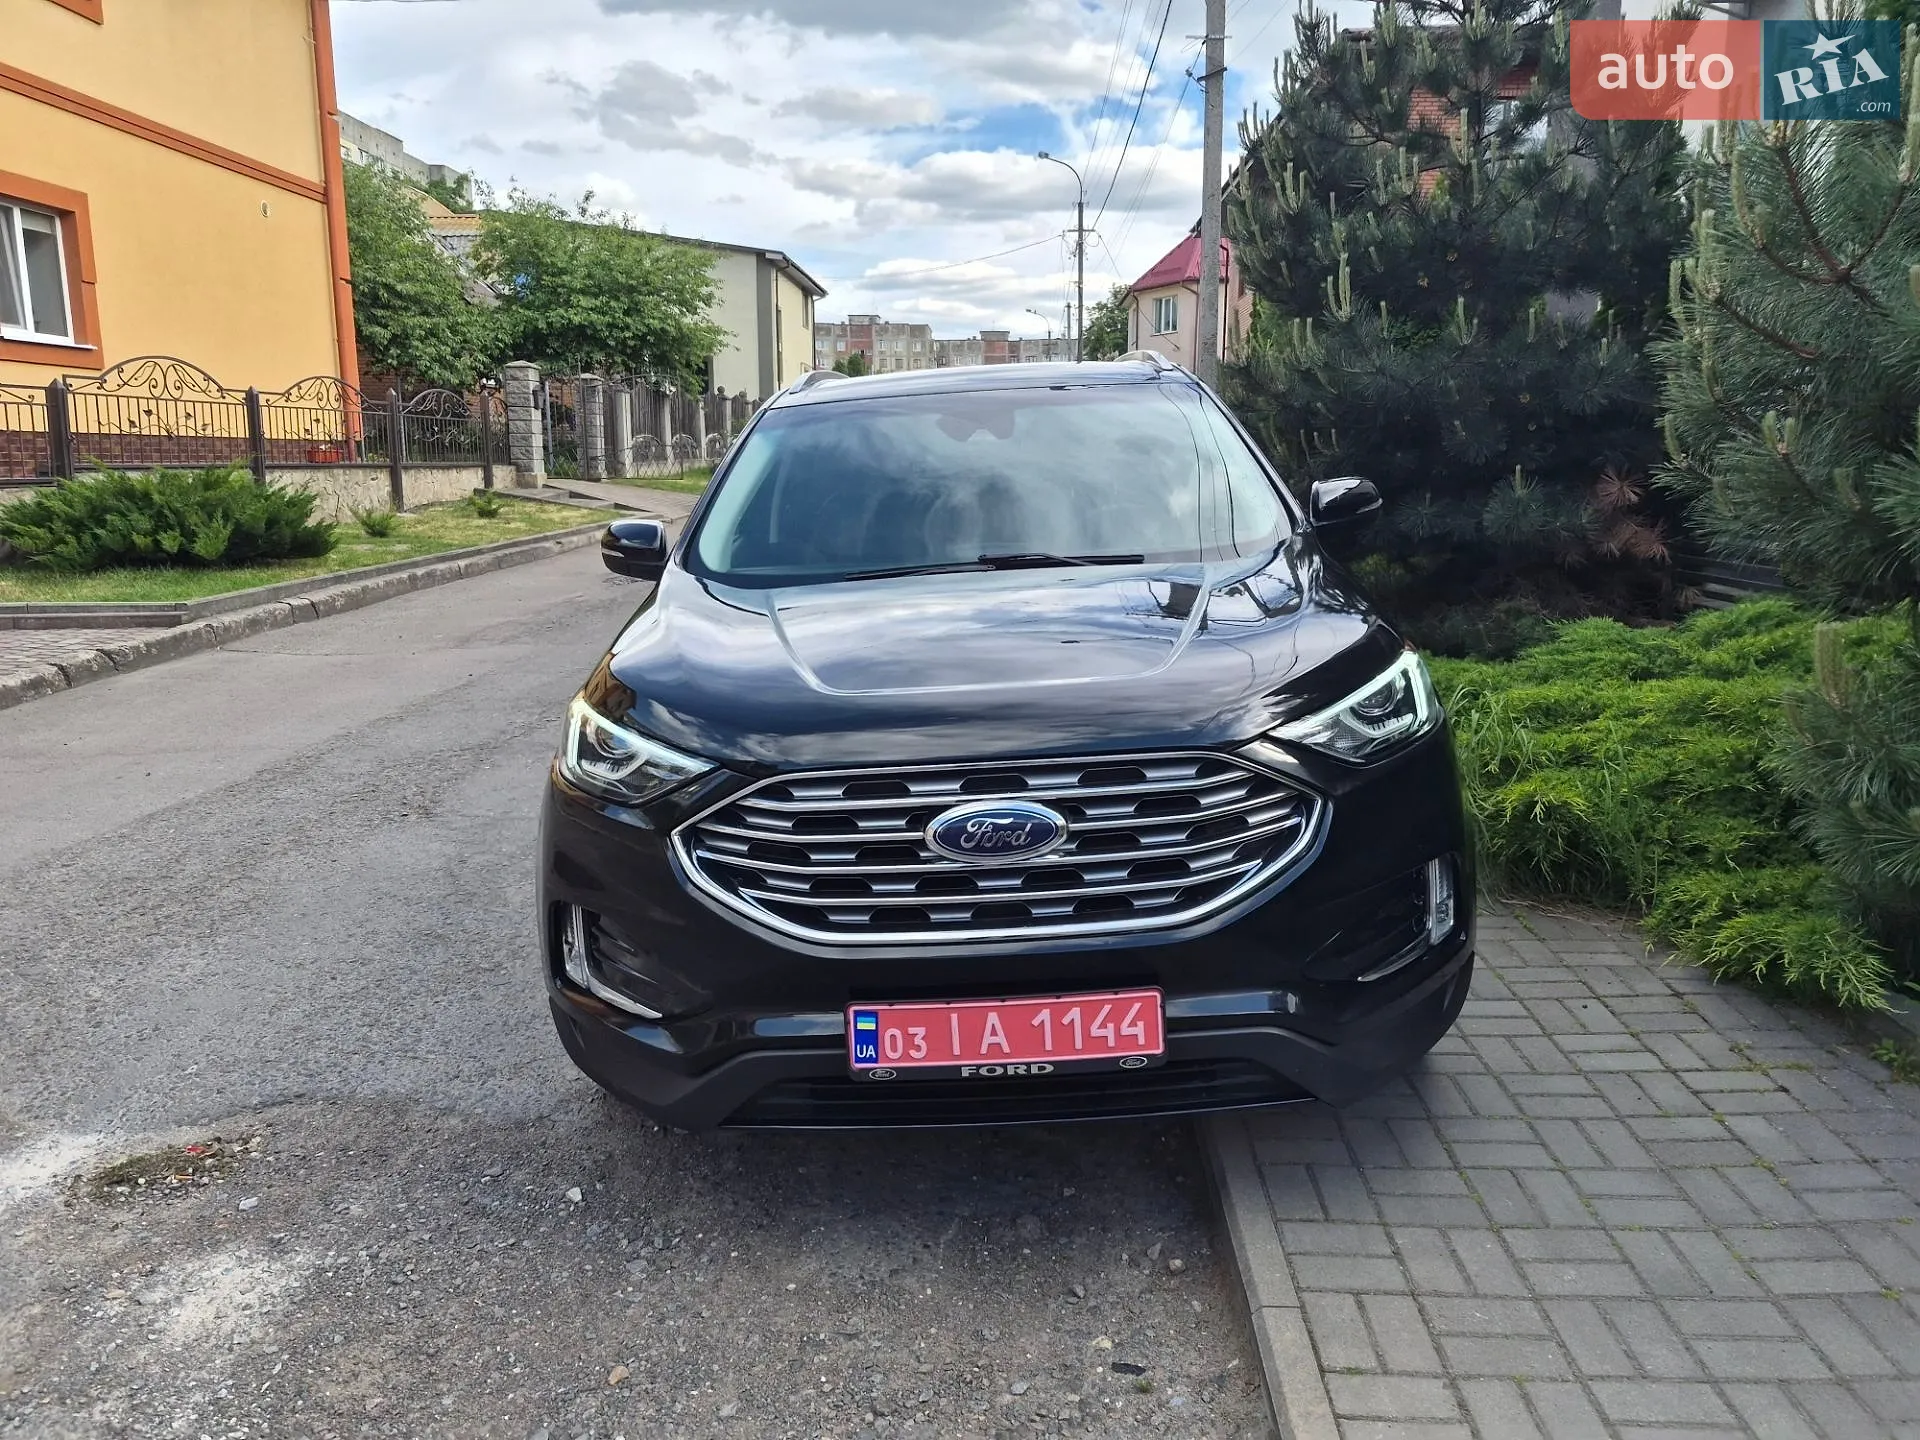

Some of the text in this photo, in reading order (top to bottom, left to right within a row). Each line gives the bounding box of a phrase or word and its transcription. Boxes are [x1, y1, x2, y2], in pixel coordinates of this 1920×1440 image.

[960, 817, 1032, 849] Ford
[883, 1027, 928, 1060] 03
[1030, 1002, 1146, 1051] 1144
[856, 1044, 877, 1059] UA
[960, 1063, 1055, 1077] FORD
